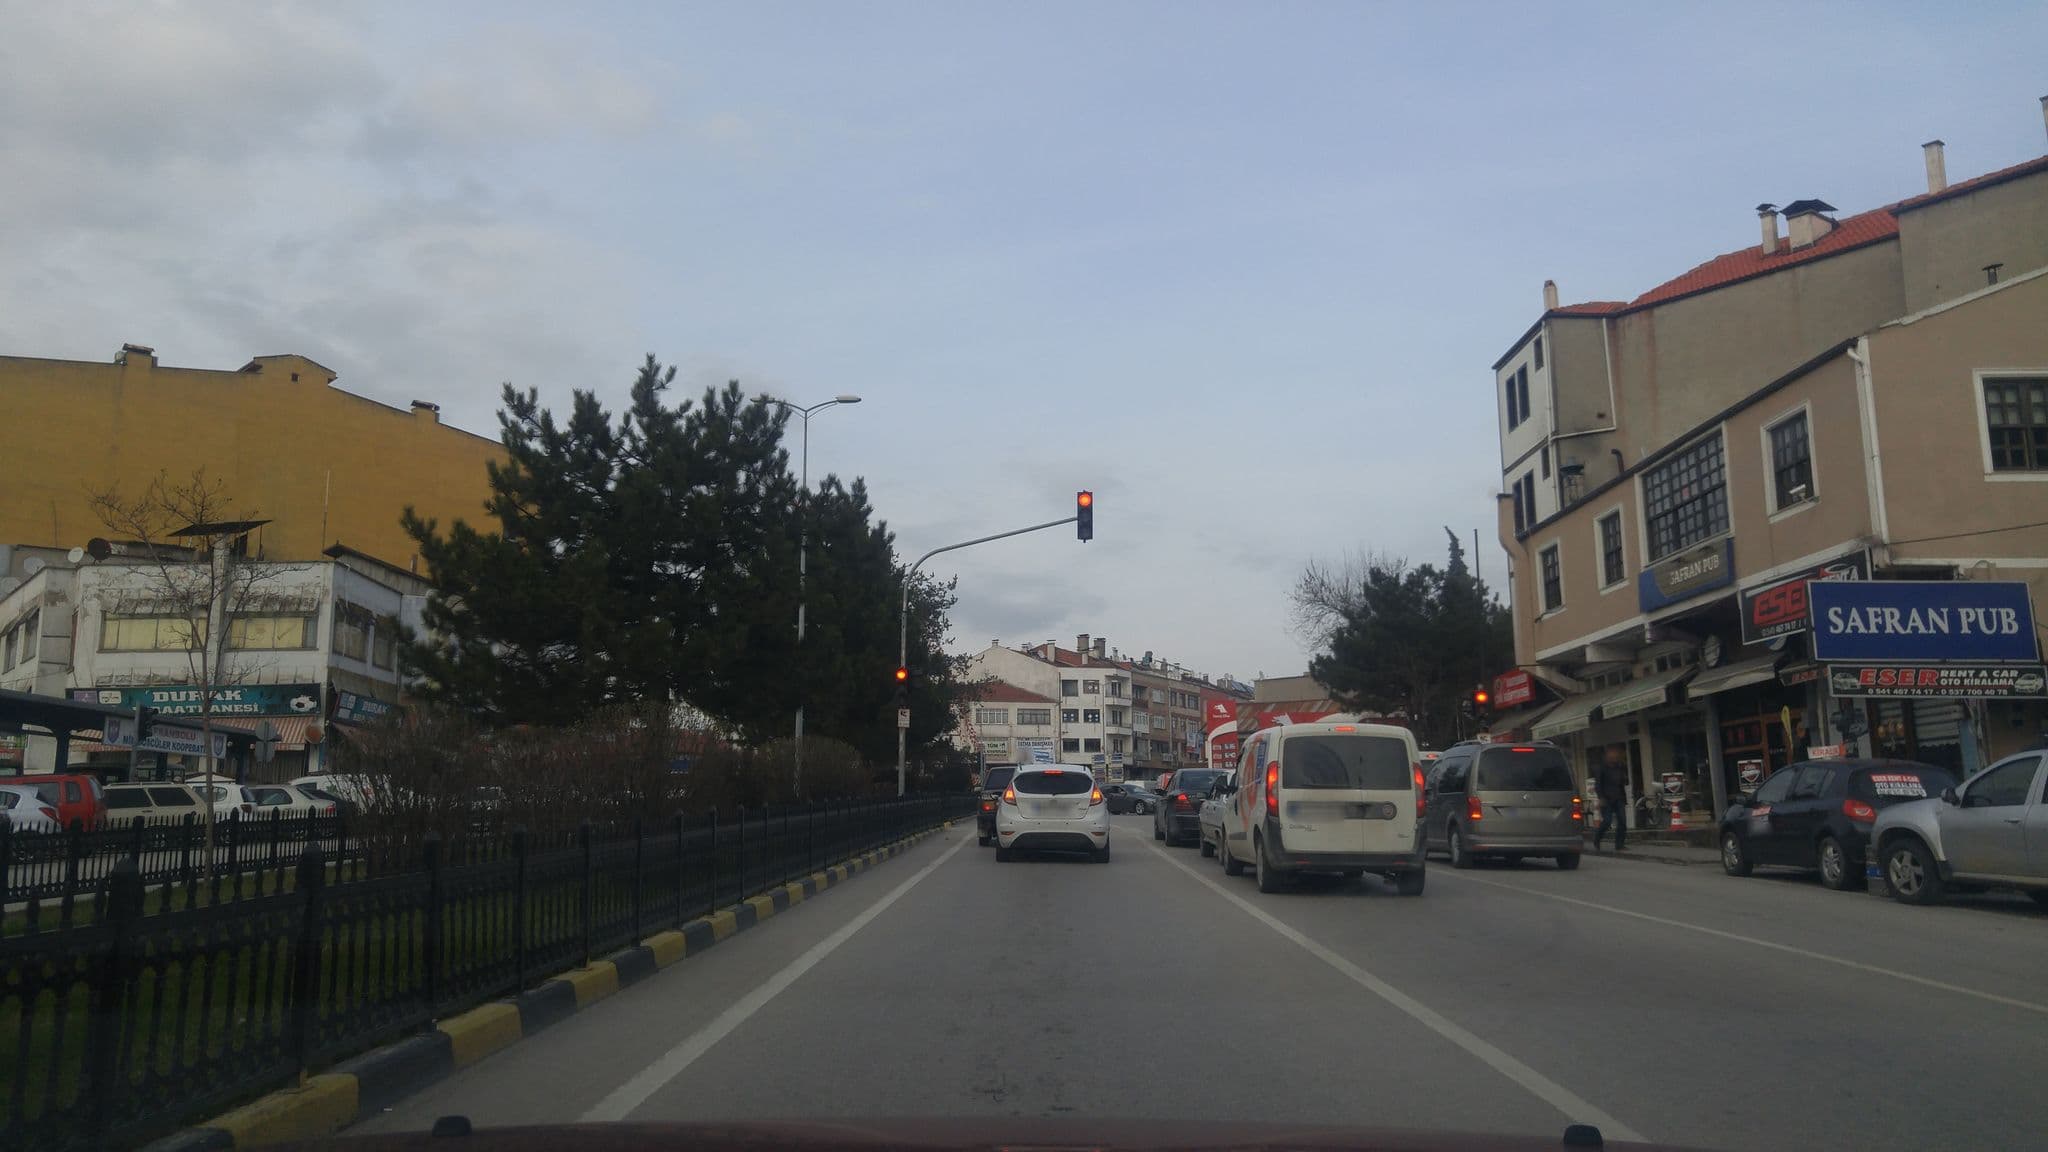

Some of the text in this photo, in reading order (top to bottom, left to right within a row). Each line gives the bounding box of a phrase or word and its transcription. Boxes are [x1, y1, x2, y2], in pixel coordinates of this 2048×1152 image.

[1669, 554, 1719, 585] SAFRAN PUB
[1827, 606, 2020, 635] SAFRAN PUB
[1860, 668, 2019, 686] ESER RENT A CAR
[1940, 678, 1961, 686] OTO
